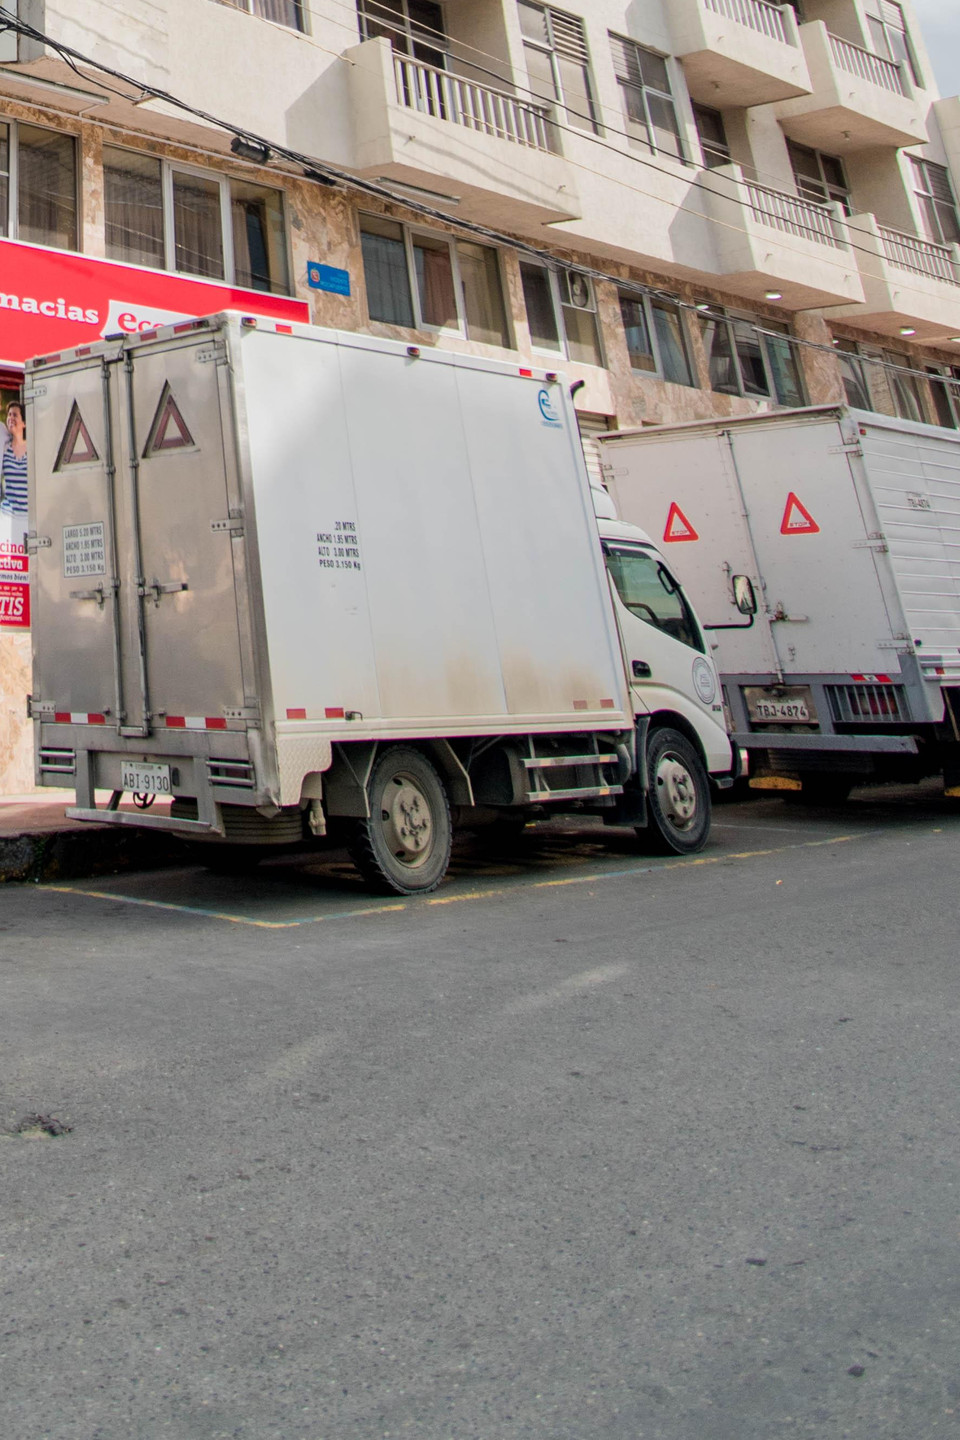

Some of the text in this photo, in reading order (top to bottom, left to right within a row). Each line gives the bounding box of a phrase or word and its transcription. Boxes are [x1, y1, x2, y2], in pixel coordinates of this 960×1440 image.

[319, 559, 335, 568] PESO
[66, 565, 80, 574] PESO
[757, 704, 807, 718] TBJ-4874
[124, 773, 169, 792] ABI-9130
